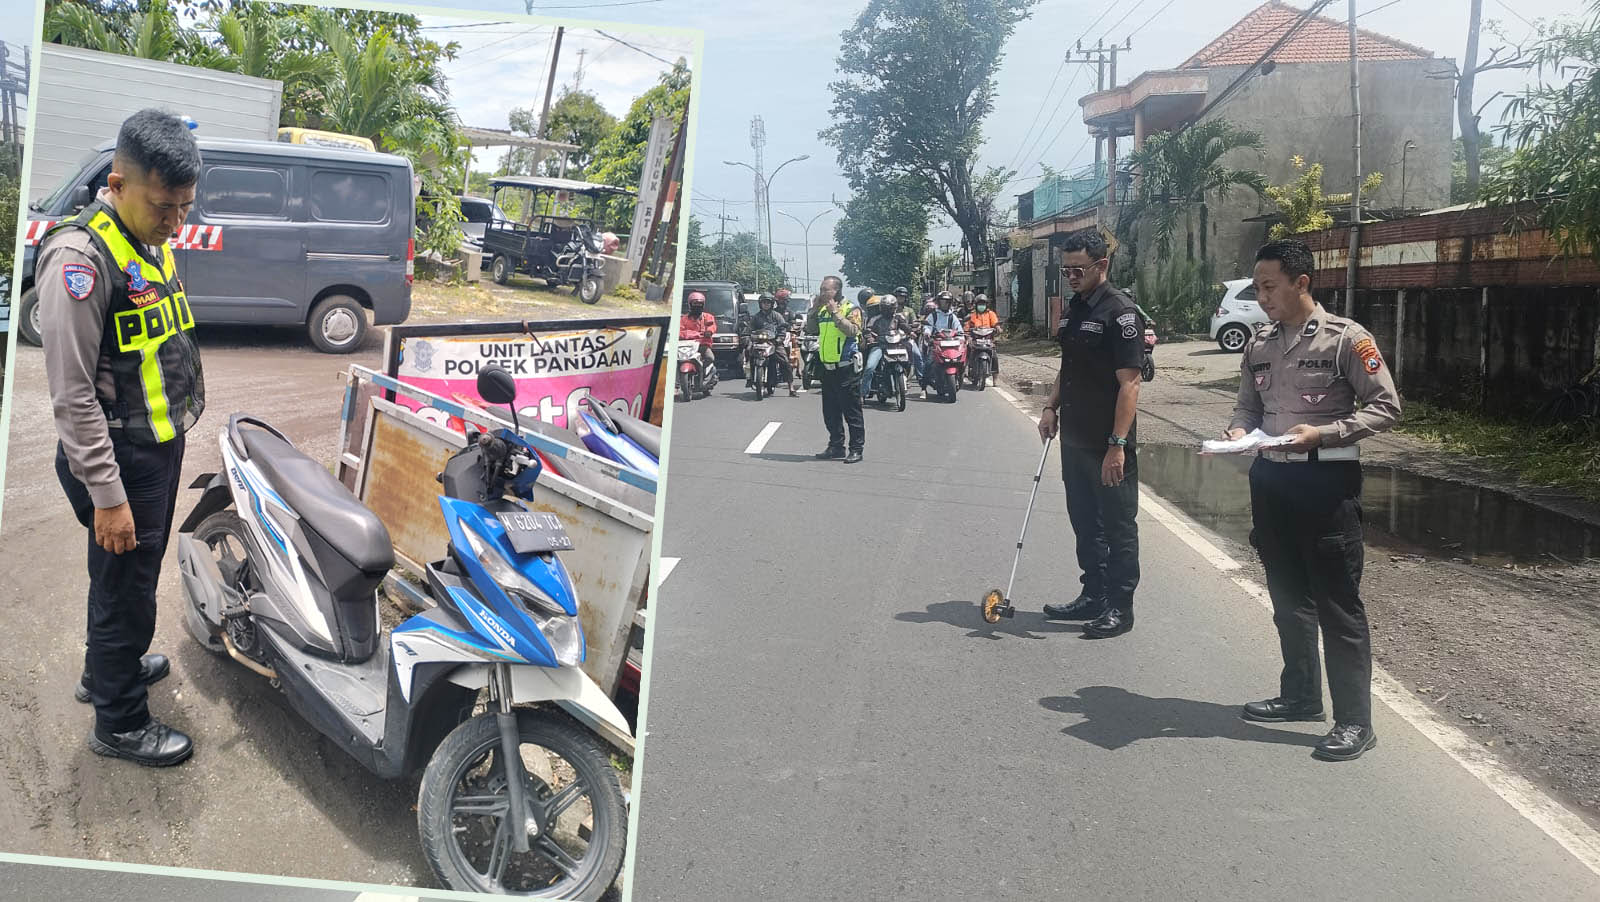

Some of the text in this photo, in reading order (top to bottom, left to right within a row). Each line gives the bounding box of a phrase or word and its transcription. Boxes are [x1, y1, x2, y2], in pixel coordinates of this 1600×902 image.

[480, 335, 606, 358] UNIT LANTAS
[534, 349, 632, 374] PANDAAN
[1297, 359, 1333, 369] POLRI
[514, 515, 543, 530] 6204
[542, 514, 565, 530] TCA
[479, 609, 516, 648] HONDA
